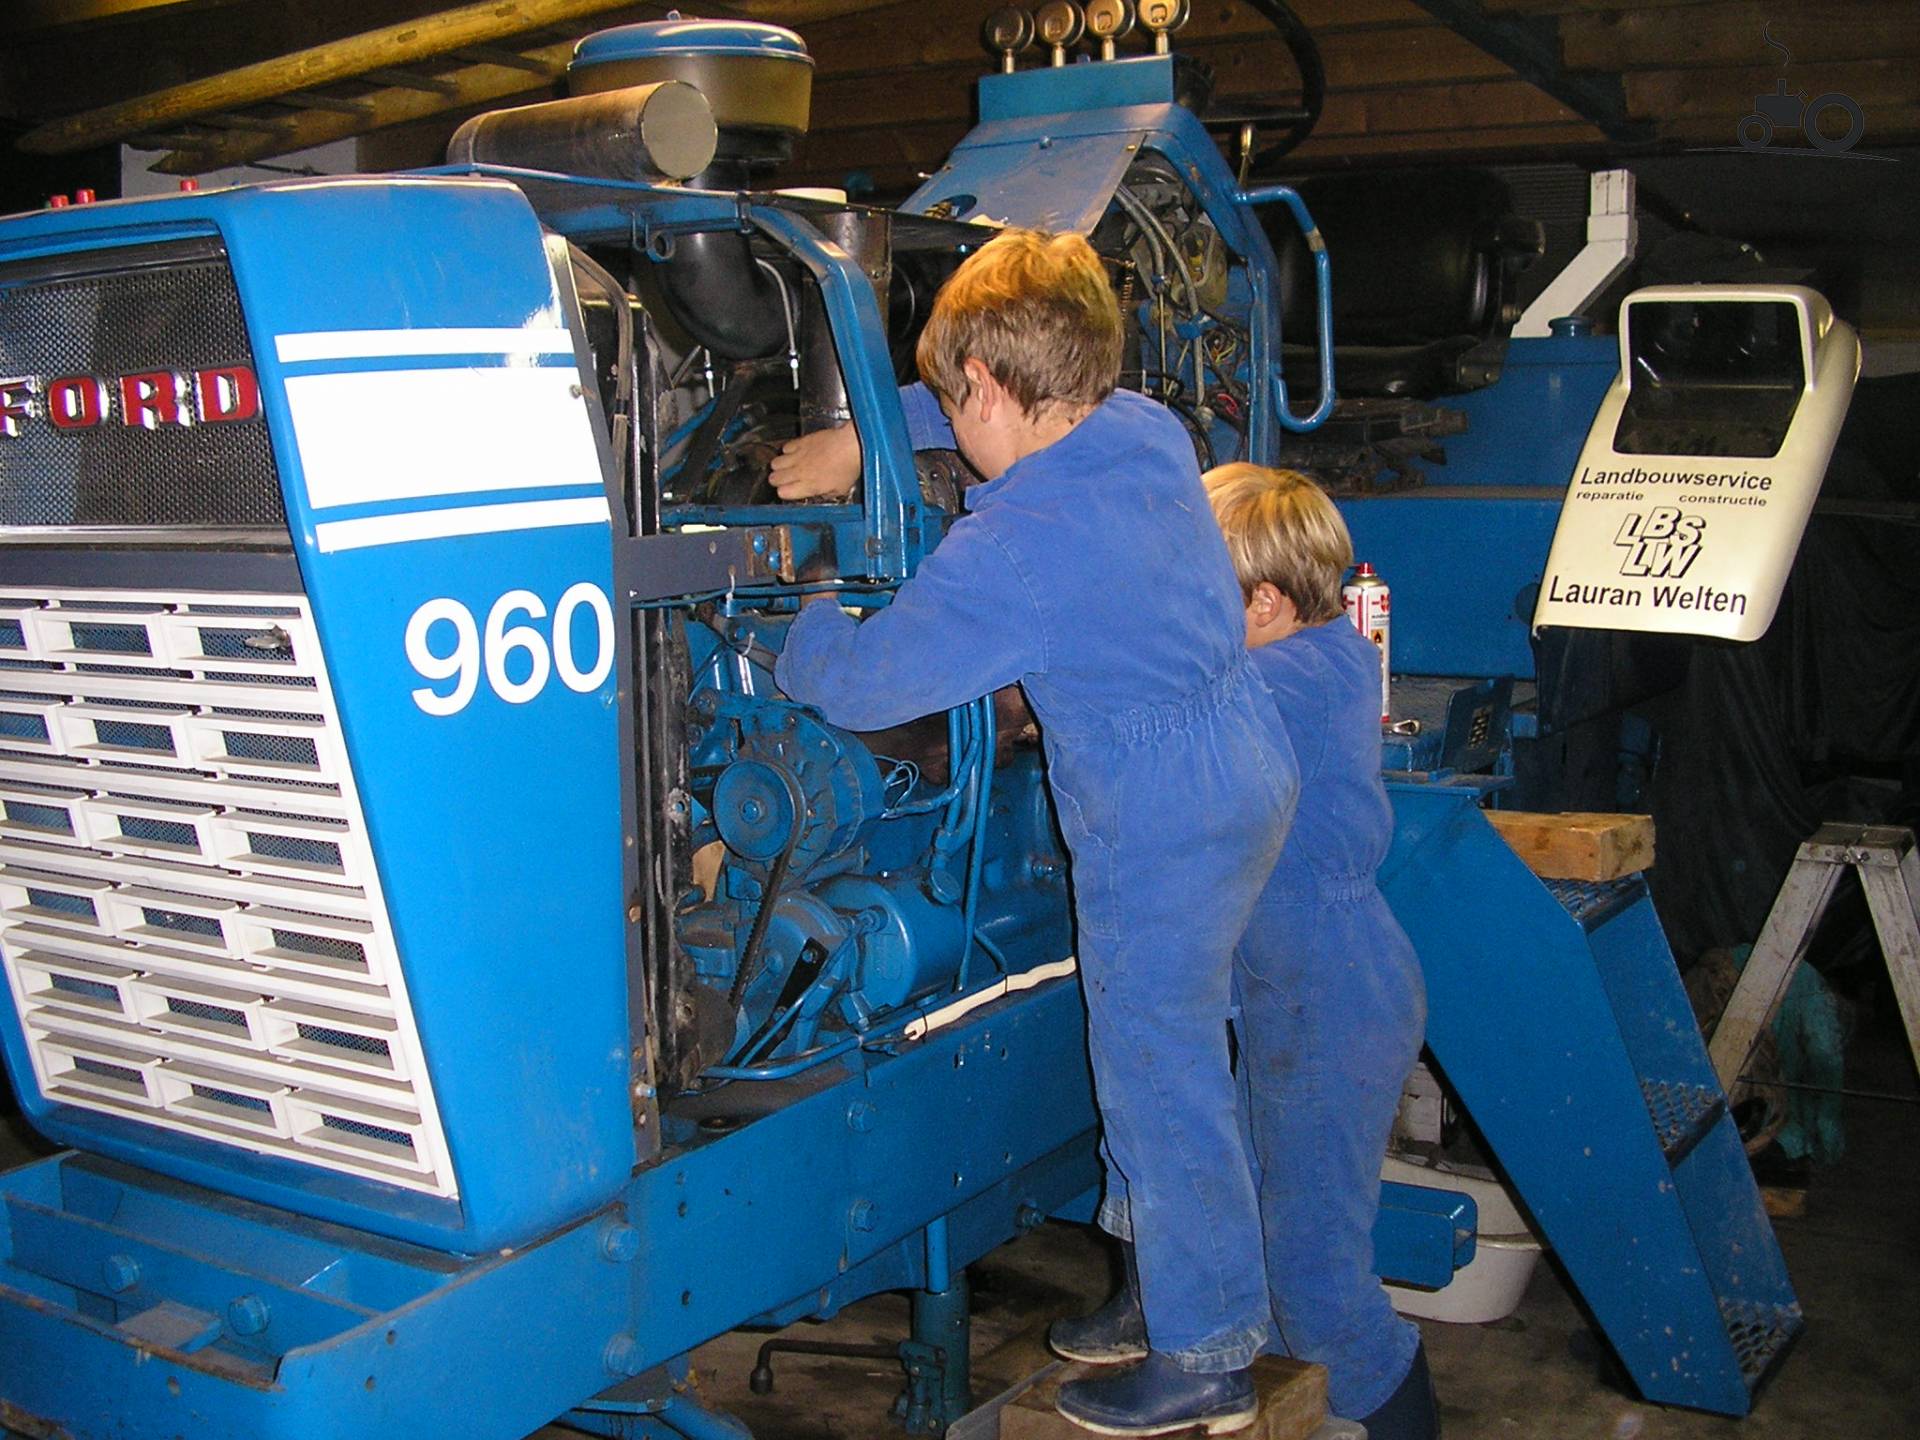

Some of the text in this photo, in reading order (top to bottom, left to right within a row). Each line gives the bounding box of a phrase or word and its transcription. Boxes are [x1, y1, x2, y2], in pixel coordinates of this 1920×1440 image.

[0, 364, 262, 437] FORD
[1576, 490, 1767, 506] reparatie constructie
[1581, 467, 1772, 491] Landbouwservice
[1549, 575, 1747, 615] Lauran Welten
[405, 582, 615, 716] 960
